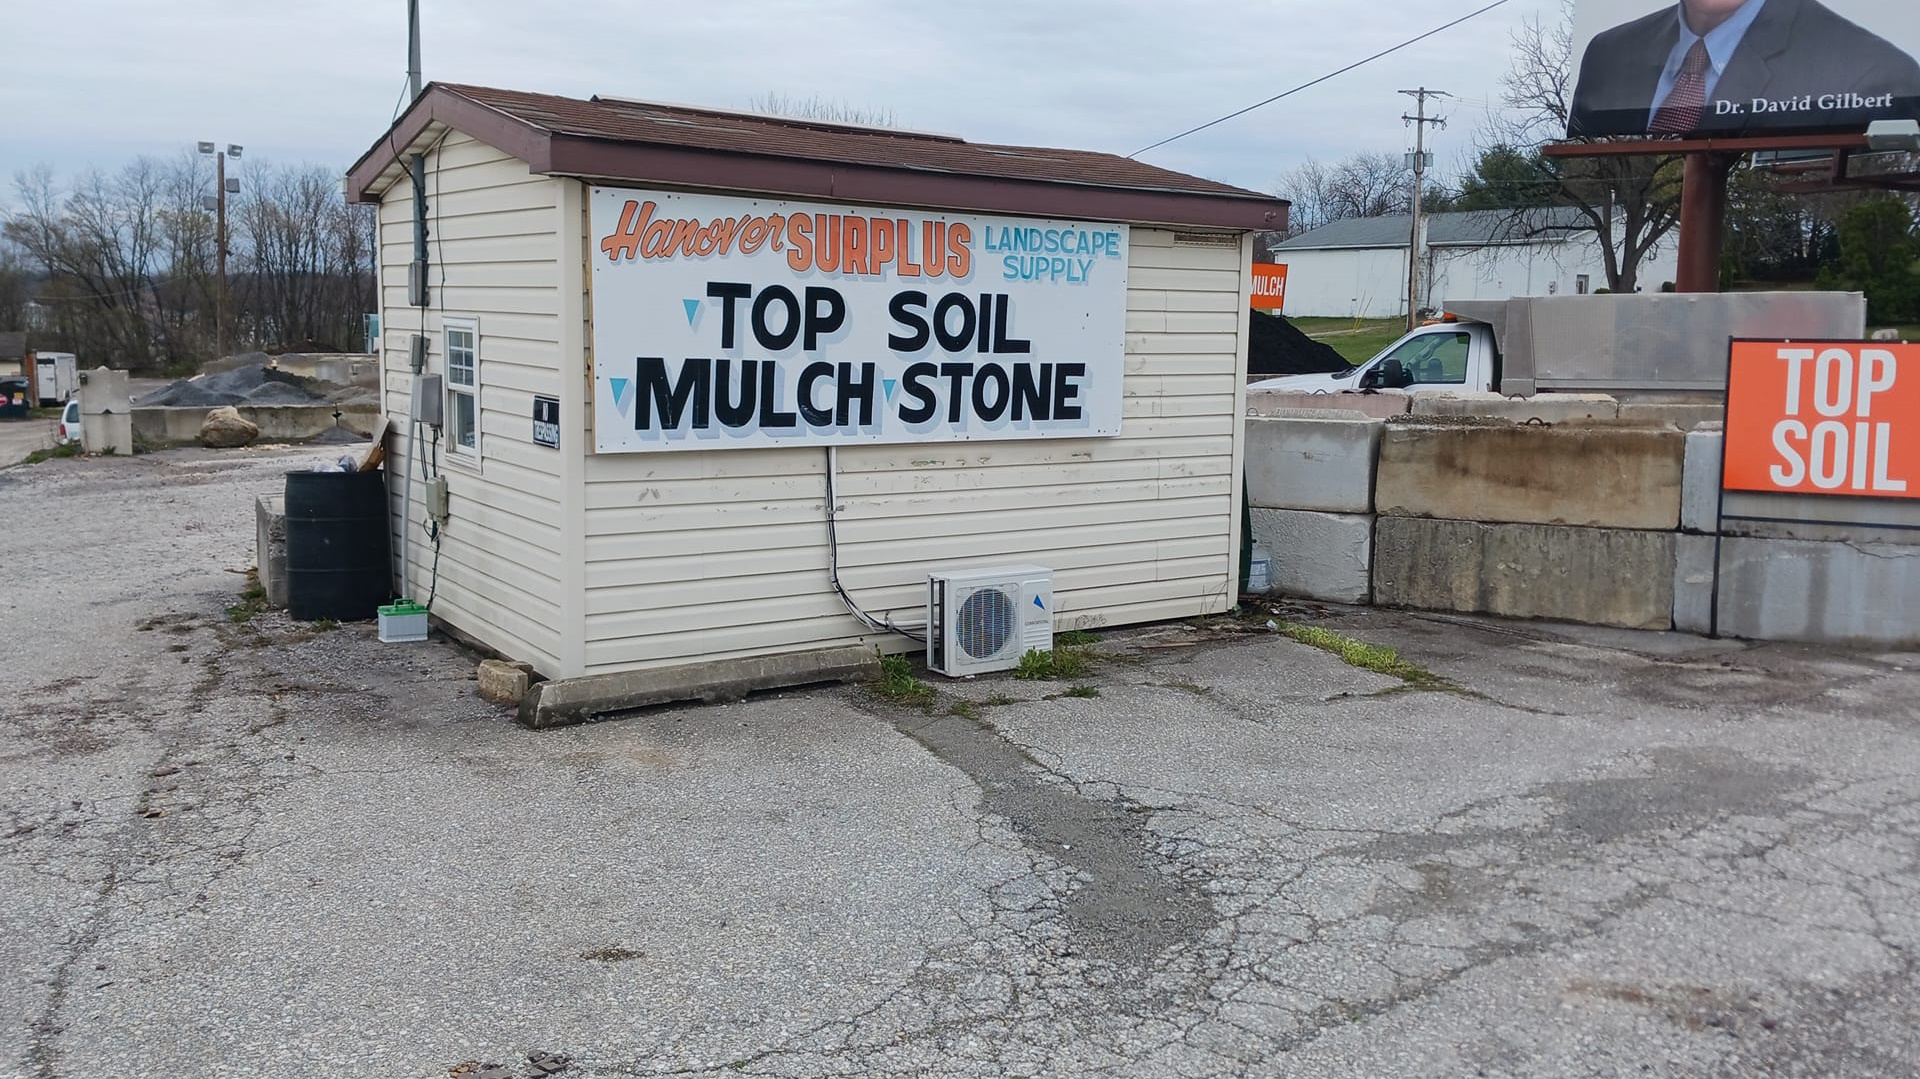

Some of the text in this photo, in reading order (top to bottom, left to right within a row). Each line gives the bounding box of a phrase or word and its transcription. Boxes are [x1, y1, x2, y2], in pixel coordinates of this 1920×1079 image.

[1715, 92, 1893, 115] Dr. David Gilbert
[601, 200, 971, 278] Hanover SURPLUS
[984, 225, 1119, 256] LANDSCAPE
[1002, 255, 1093, 282] SUPPLY
[707, 282, 1030, 354] TOP SOIL
[1250, 275, 1284, 297] MULCH
[635, 357, 1086, 430] MULCH STONE
[1776, 348, 1898, 417] TOP
[1769, 419, 1908, 492] SOIL
